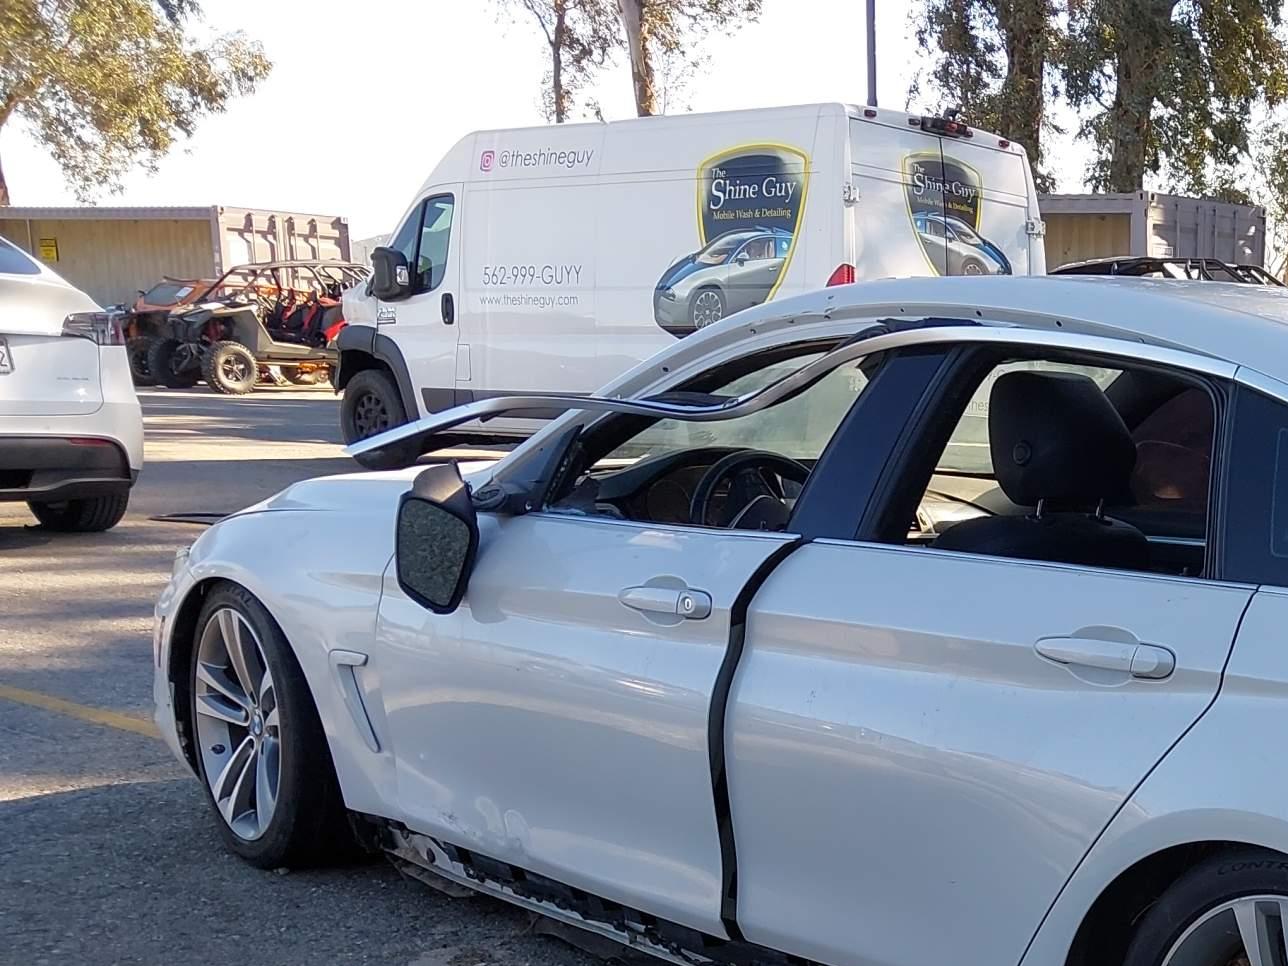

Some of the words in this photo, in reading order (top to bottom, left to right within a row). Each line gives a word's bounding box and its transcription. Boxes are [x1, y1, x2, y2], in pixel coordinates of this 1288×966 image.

[499, 147, 594, 169] @theshineguy
[712, 168, 726, 179] The
[710, 179, 758, 210] Shine
[762, 177, 797, 203] Guy
[914, 173, 950, 195] Shine
[952, 181, 976, 203] Guy
[712, 210, 735, 220] Mobile
[736, 209, 753, 219] Wash
[754, 209, 761, 218] &
[761, 207, 791, 219] Detailing
[482, 265, 582, 285] 562-999-GUYY
[480, 293, 579, 309] www.theshineguy.com
